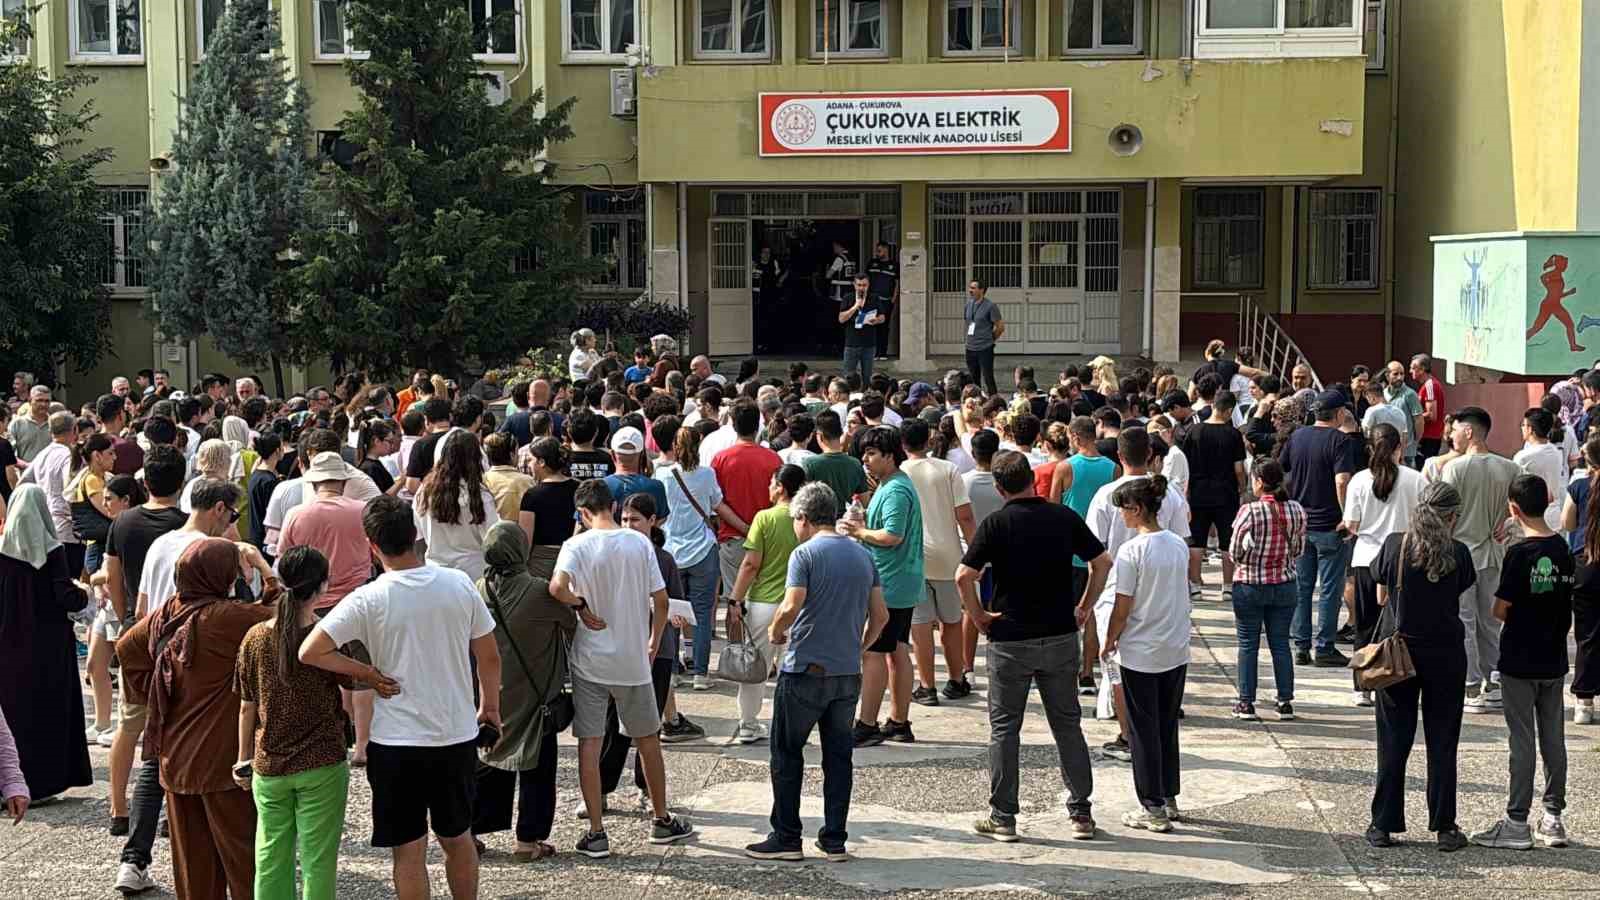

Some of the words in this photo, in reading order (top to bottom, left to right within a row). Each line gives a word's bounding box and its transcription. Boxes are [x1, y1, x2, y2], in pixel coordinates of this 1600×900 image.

[826, 102, 854, 110] ADANA
[859, 101, 902, 111] ÇUKUROVA
[826, 112, 930, 134] ÇUKUROVA
[935, 106, 1021, 128] ELEKTRİK
[826, 133, 872, 145] MESLEKİ
[874, 135, 889, 145] VE
[891, 131, 930, 144] TEKNİK
[933, 133, 988, 144] ANADOLU
[991, 130, 1022, 143] LİSESİ
